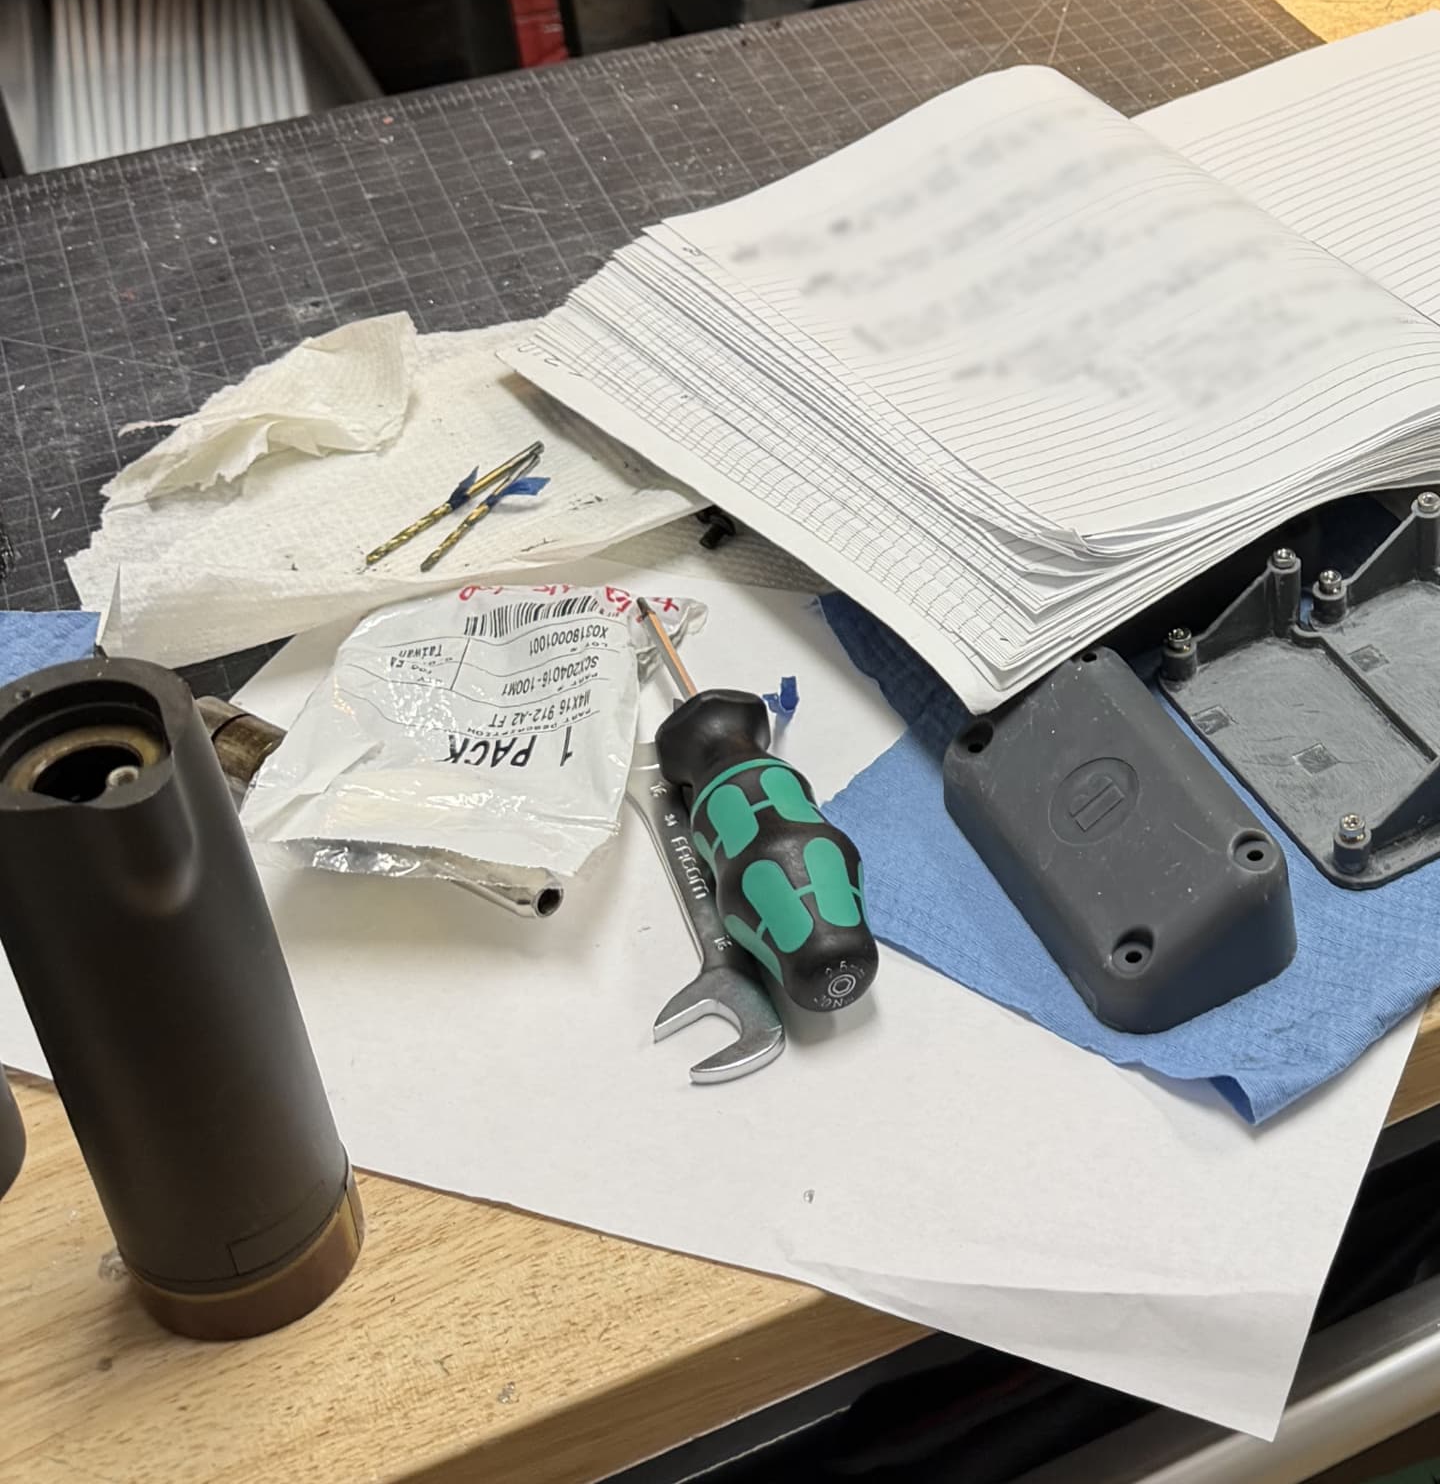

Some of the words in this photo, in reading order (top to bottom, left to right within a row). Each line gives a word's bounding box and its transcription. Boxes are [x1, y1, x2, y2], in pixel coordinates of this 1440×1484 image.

[397, 643, 443, 664] Taiwan
[488, 712, 508, 729] FT
[511, 703, 556, 725] 912-A2
[466, 721, 559, 737] DESCRIPTION
[435, 733, 539, 769] PACK
